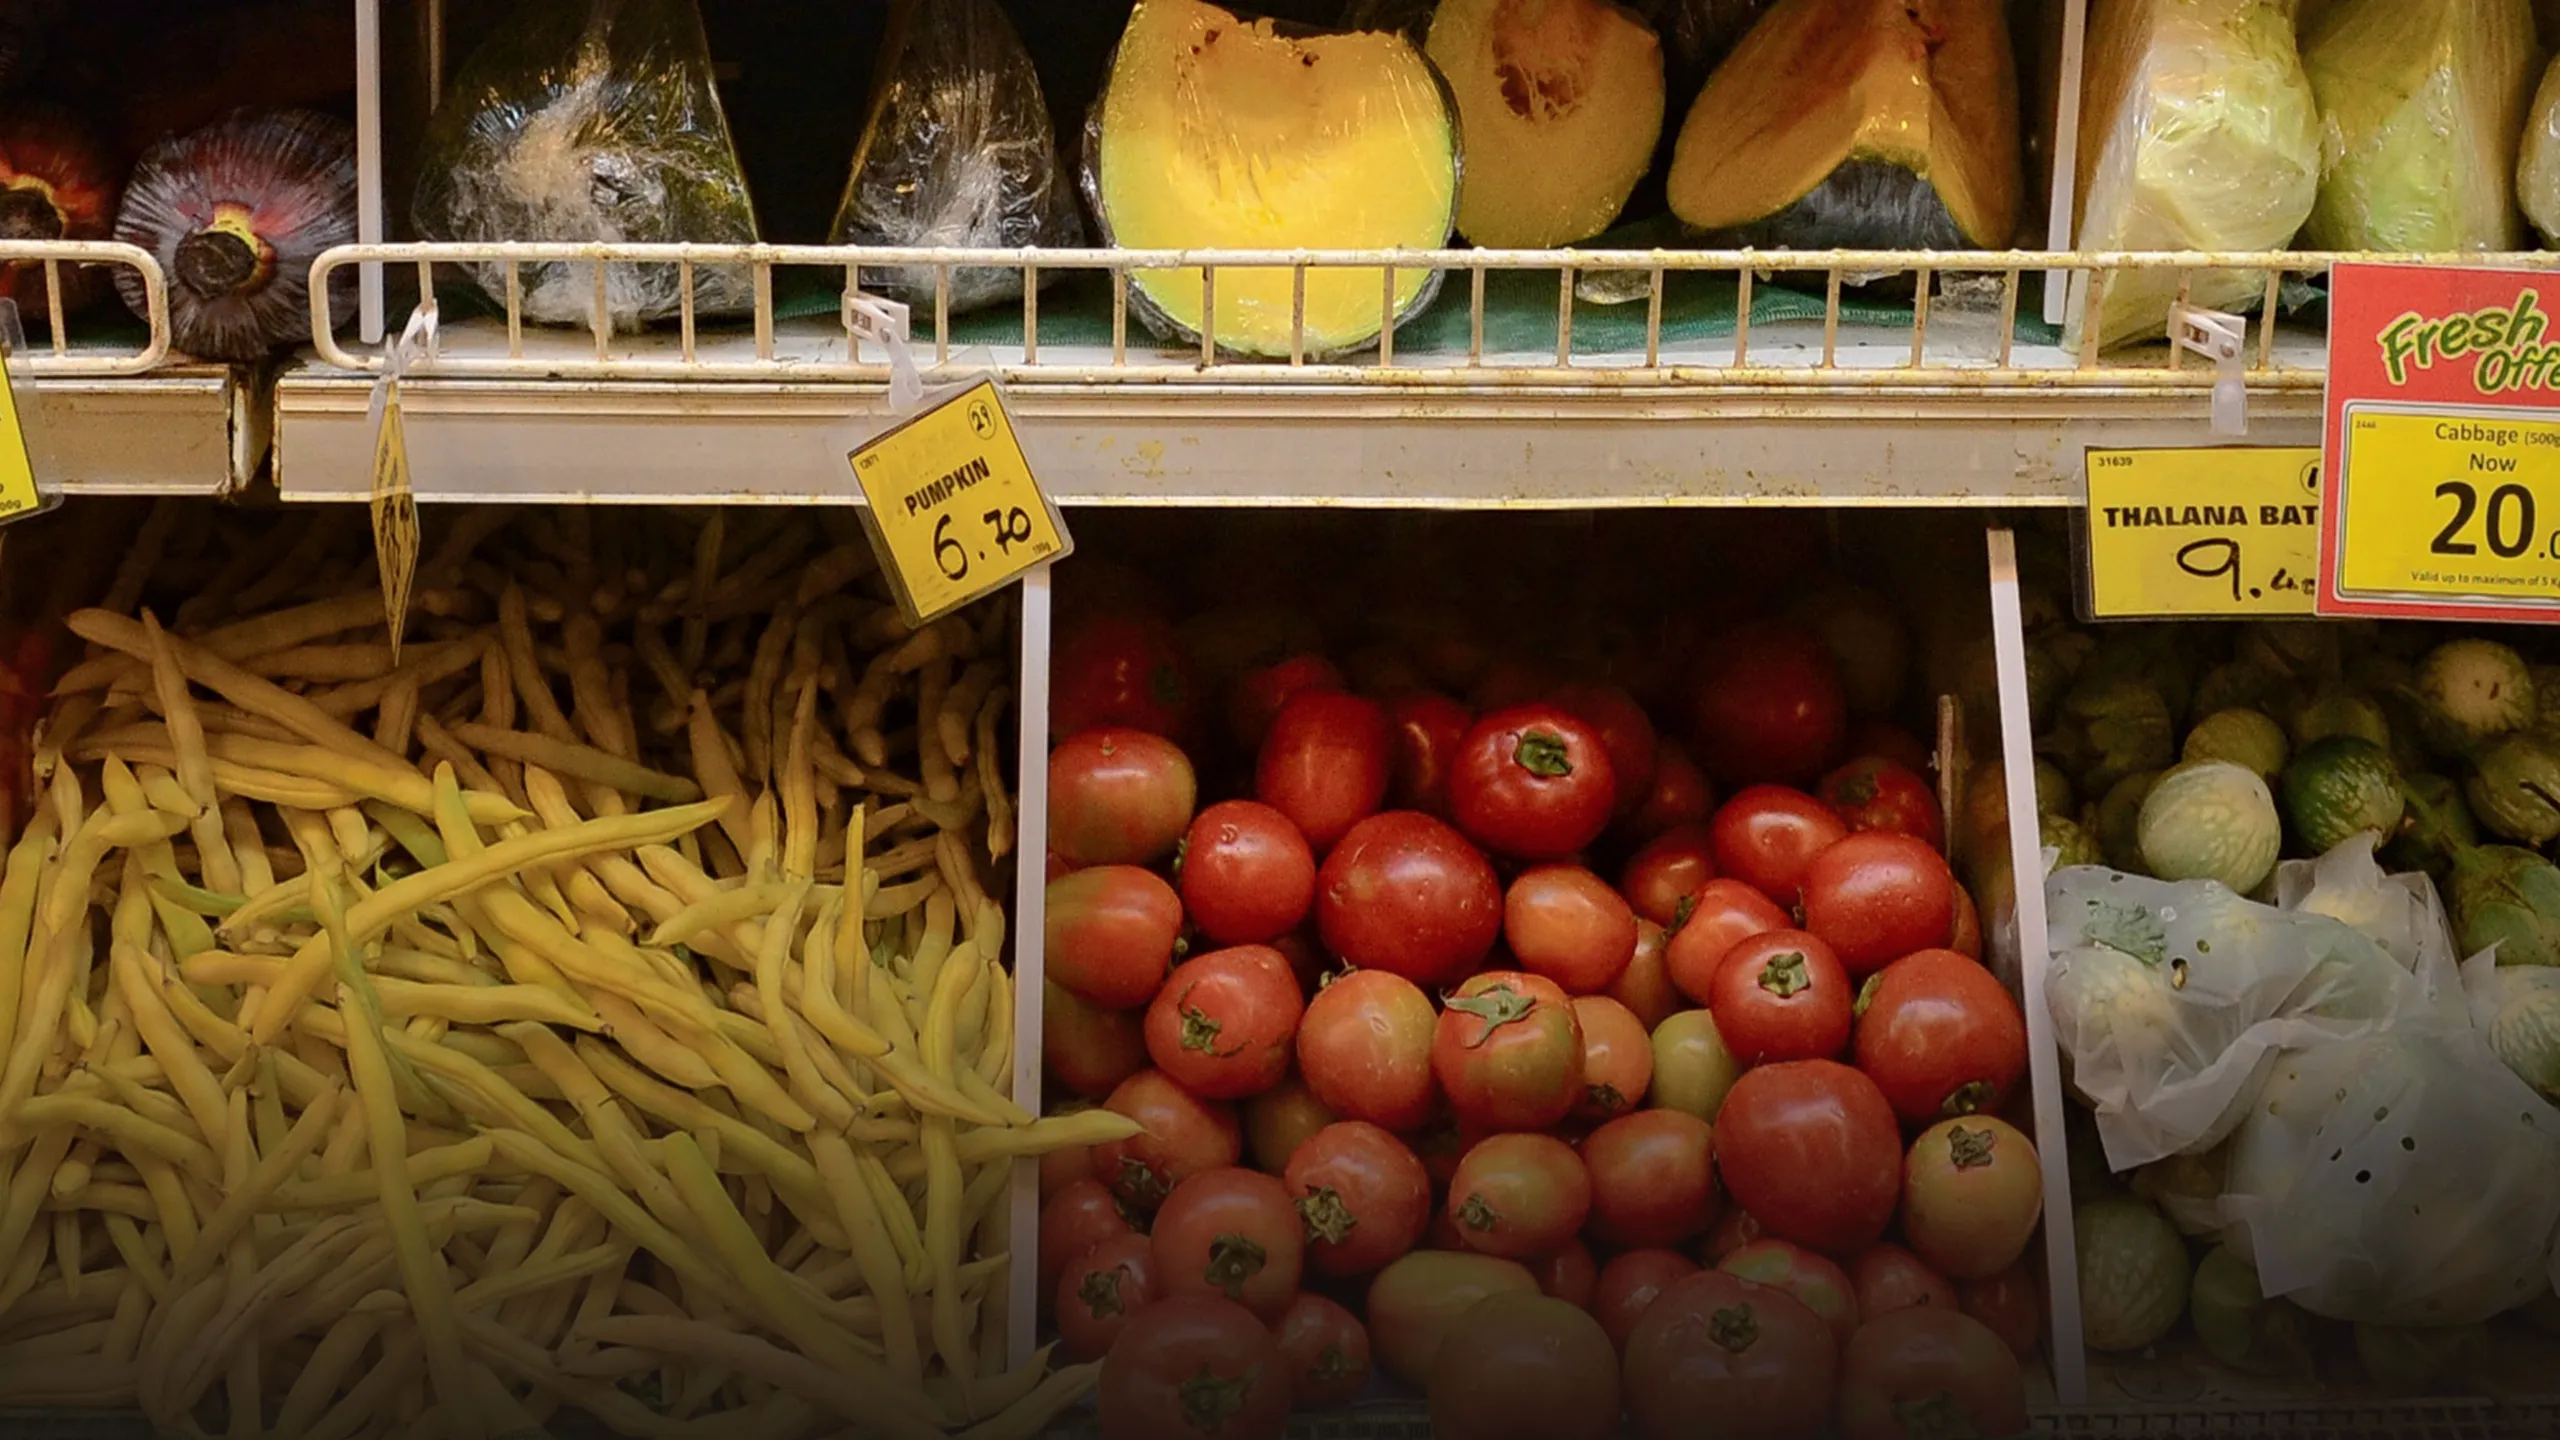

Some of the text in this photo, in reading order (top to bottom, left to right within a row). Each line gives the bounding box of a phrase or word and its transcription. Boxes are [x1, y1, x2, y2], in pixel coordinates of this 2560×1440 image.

[2379, 289, 2547, 385] Fresh
[2435, 423, 2519, 447] Cabbage
[2097, 456, 2133, 467] 31639
[2469, 453, 2517, 472] Now
[904, 456, 991, 517] PUMPKIN
[2103, 505, 2248, 527] THALANA
[933, 506, 1032, 581] 6.70
[2411, 571, 2439, 582] Valid
[2442, 574, 2456, 585] up
[2458, 573, 2470, 583] to
[2472, 573, 2526, 585] maximum
[2527, 576, 2539, 586] of
